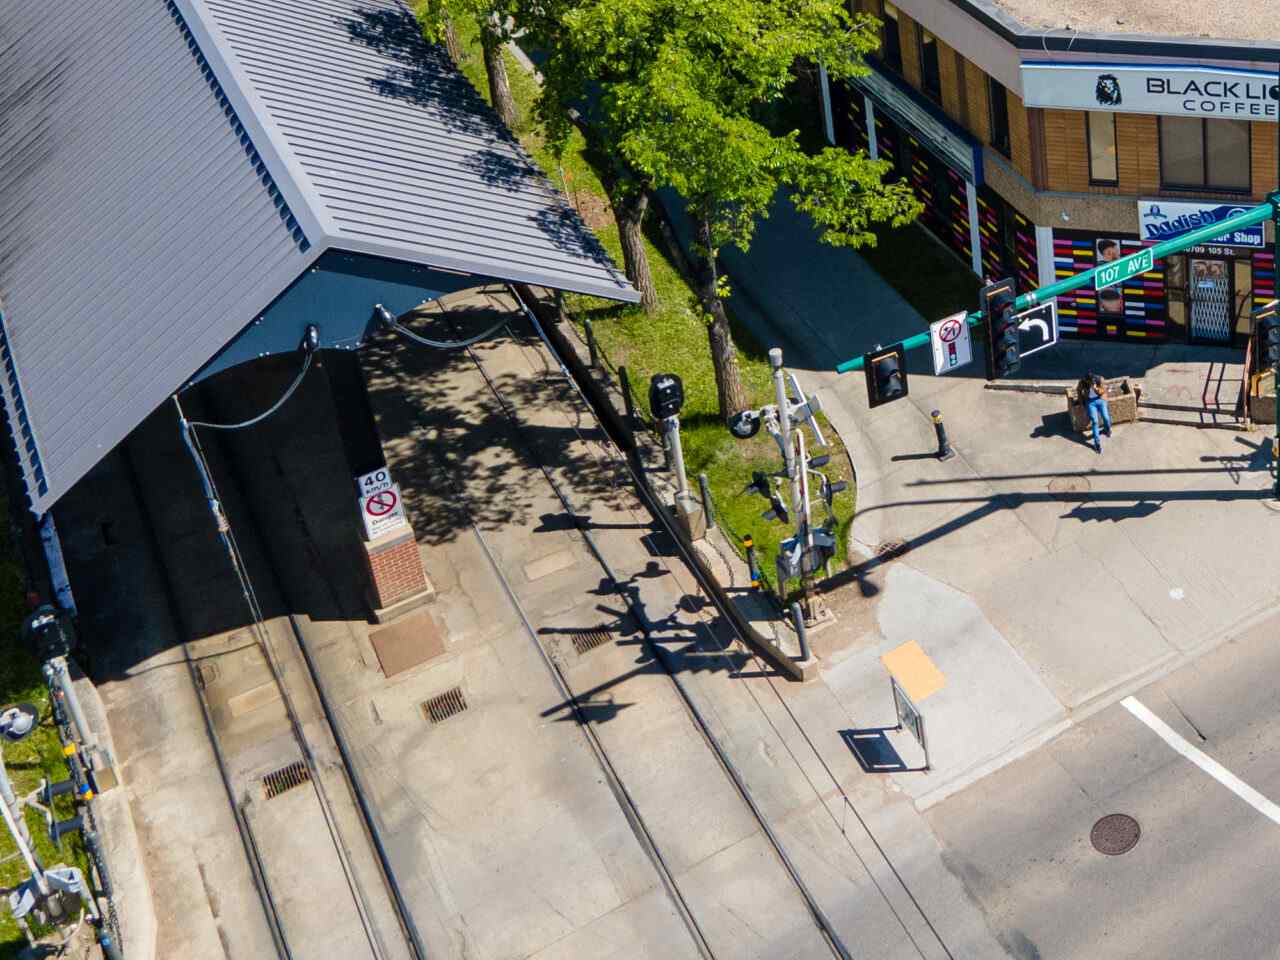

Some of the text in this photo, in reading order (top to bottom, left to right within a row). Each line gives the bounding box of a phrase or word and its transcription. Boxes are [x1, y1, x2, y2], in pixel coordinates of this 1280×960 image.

[1146, 77, 1240, 99] BLACK
[1183, 99, 1276, 116] COFFEE
[1234, 232, 1260, 245] Shop
[1100, 254, 1149, 283] 107 AVE
[365, 471, 386, 486] 40
